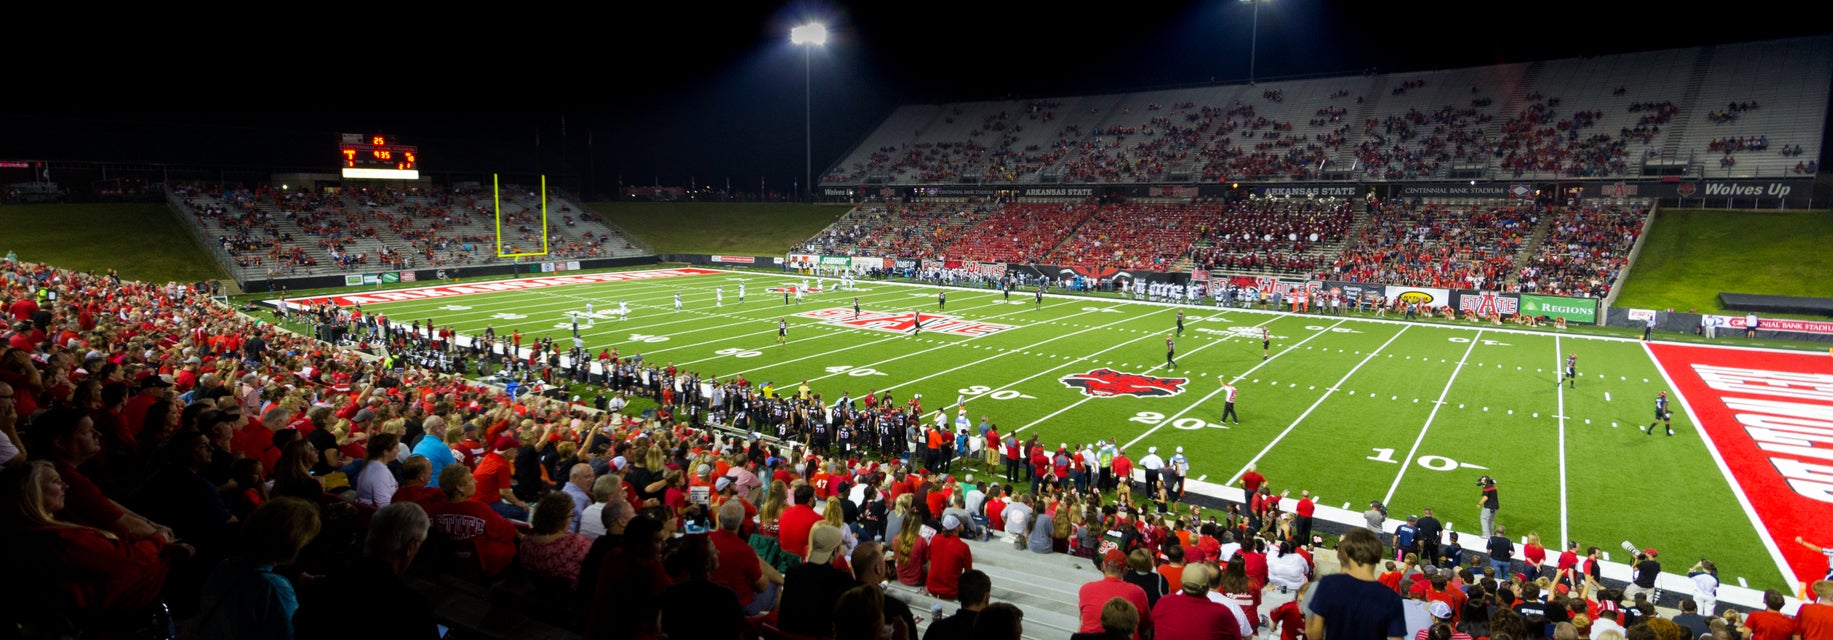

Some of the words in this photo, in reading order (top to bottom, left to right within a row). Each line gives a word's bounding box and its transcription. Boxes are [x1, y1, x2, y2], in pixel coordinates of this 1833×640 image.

[824, 188, 846, 196] Wolves
[1025, 188, 1066, 196] ARKANSAS
[1067, 188, 1093, 196] STATE
[1264, 188, 1319, 196] ARKANSAS
[1321, 188, 1356, 196] STATE
[1705, 183, 1763, 195] Wolves
[1767, 183, 1791, 198] Up
[1460, 291, 1519, 316] STATE
[1541, 303, 1595, 315] REGIONS
[1782, 321, 1803, 330] BANK
[1804, 323, 1833, 333] STADIU
[825, 364, 876, 377] 40
[958, 385, 1021, 400] 30
[1128, 411, 1207, 431] 20
[1366, 447, 1458, 472] 10
[816, 479, 828, 489] 47
